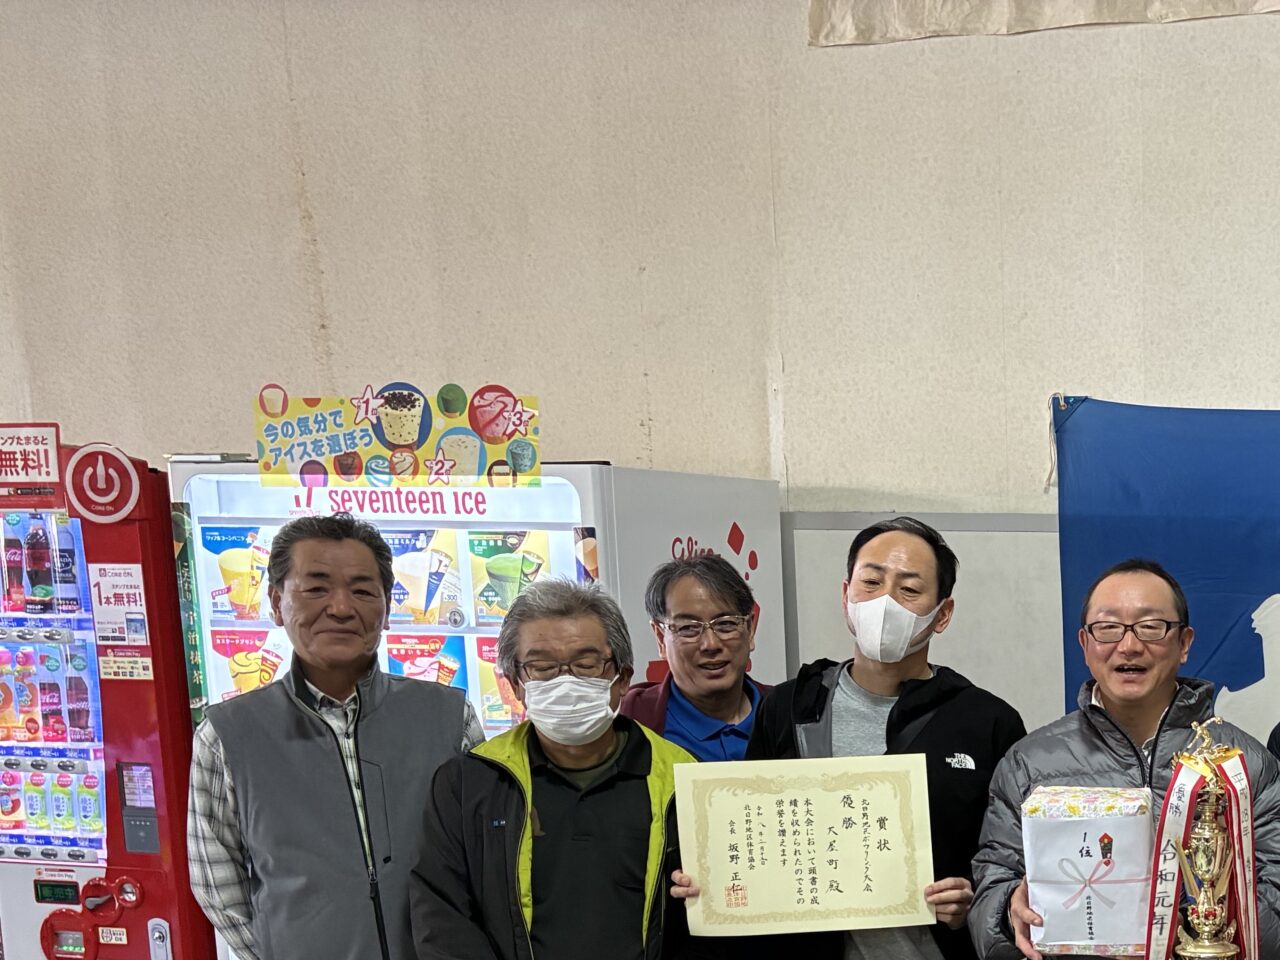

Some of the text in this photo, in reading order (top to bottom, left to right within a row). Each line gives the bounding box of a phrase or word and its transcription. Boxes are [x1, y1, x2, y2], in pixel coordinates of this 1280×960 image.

[263, 409, 344, 444] 今の気分で
[268, 426, 375, 466] アイスを選ぼう
[327, 486, 486, 515] seventeen ice
[840, 794, 857, 830] 優勝
[789, 798, 805, 905] 績を収められたのでその
[803, 797, 820, 905] 本大会において頭書の成
[876, 815, 892, 852] 賞状
